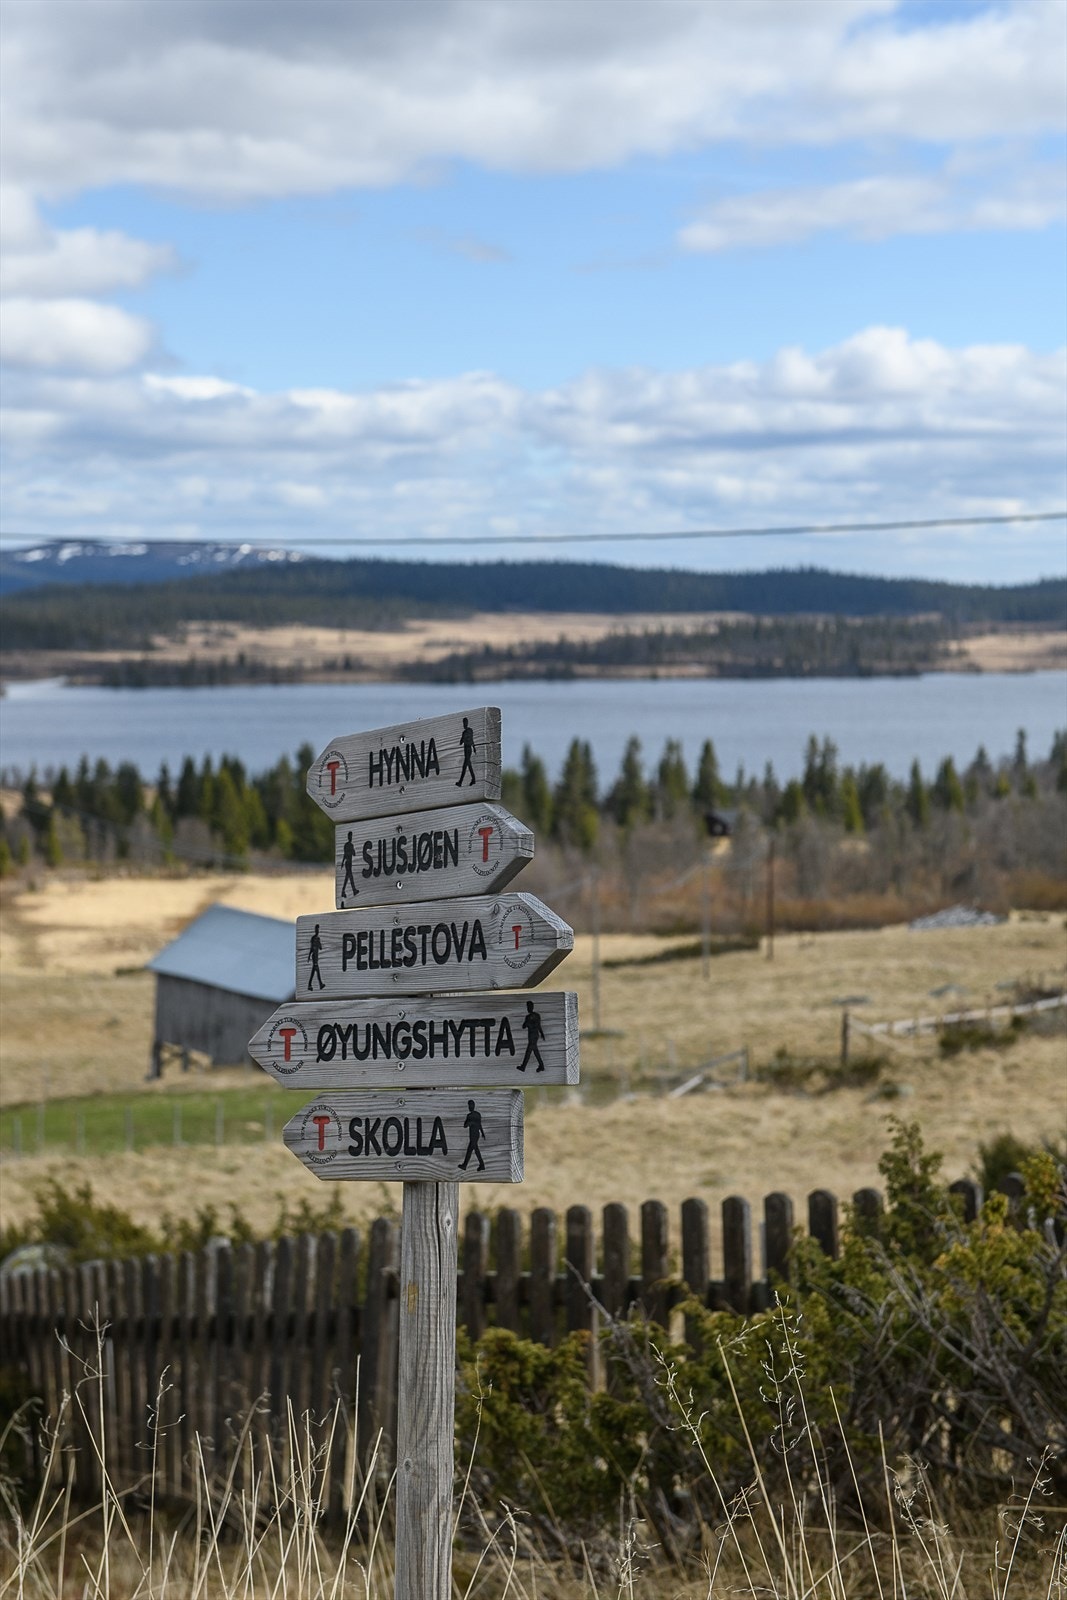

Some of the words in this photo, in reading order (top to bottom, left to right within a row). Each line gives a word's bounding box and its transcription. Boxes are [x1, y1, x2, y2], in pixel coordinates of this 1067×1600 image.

[327, 760, 340, 796] T
[368, 738, 441, 788] HYNNA
[361, 828, 459, 879] SJUSJØEN
[478, 826, 494, 863] T
[341, 919, 488, 972] PELLESTOVA
[511, 925, 522, 951] T
[279, 1028, 297, 1062] T
[316, 1016, 516, 1063] ØYUNGSHYTTA
[312, 1115, 331, 1151] T
[347, 1116, 448, 1156] SKOLLA
